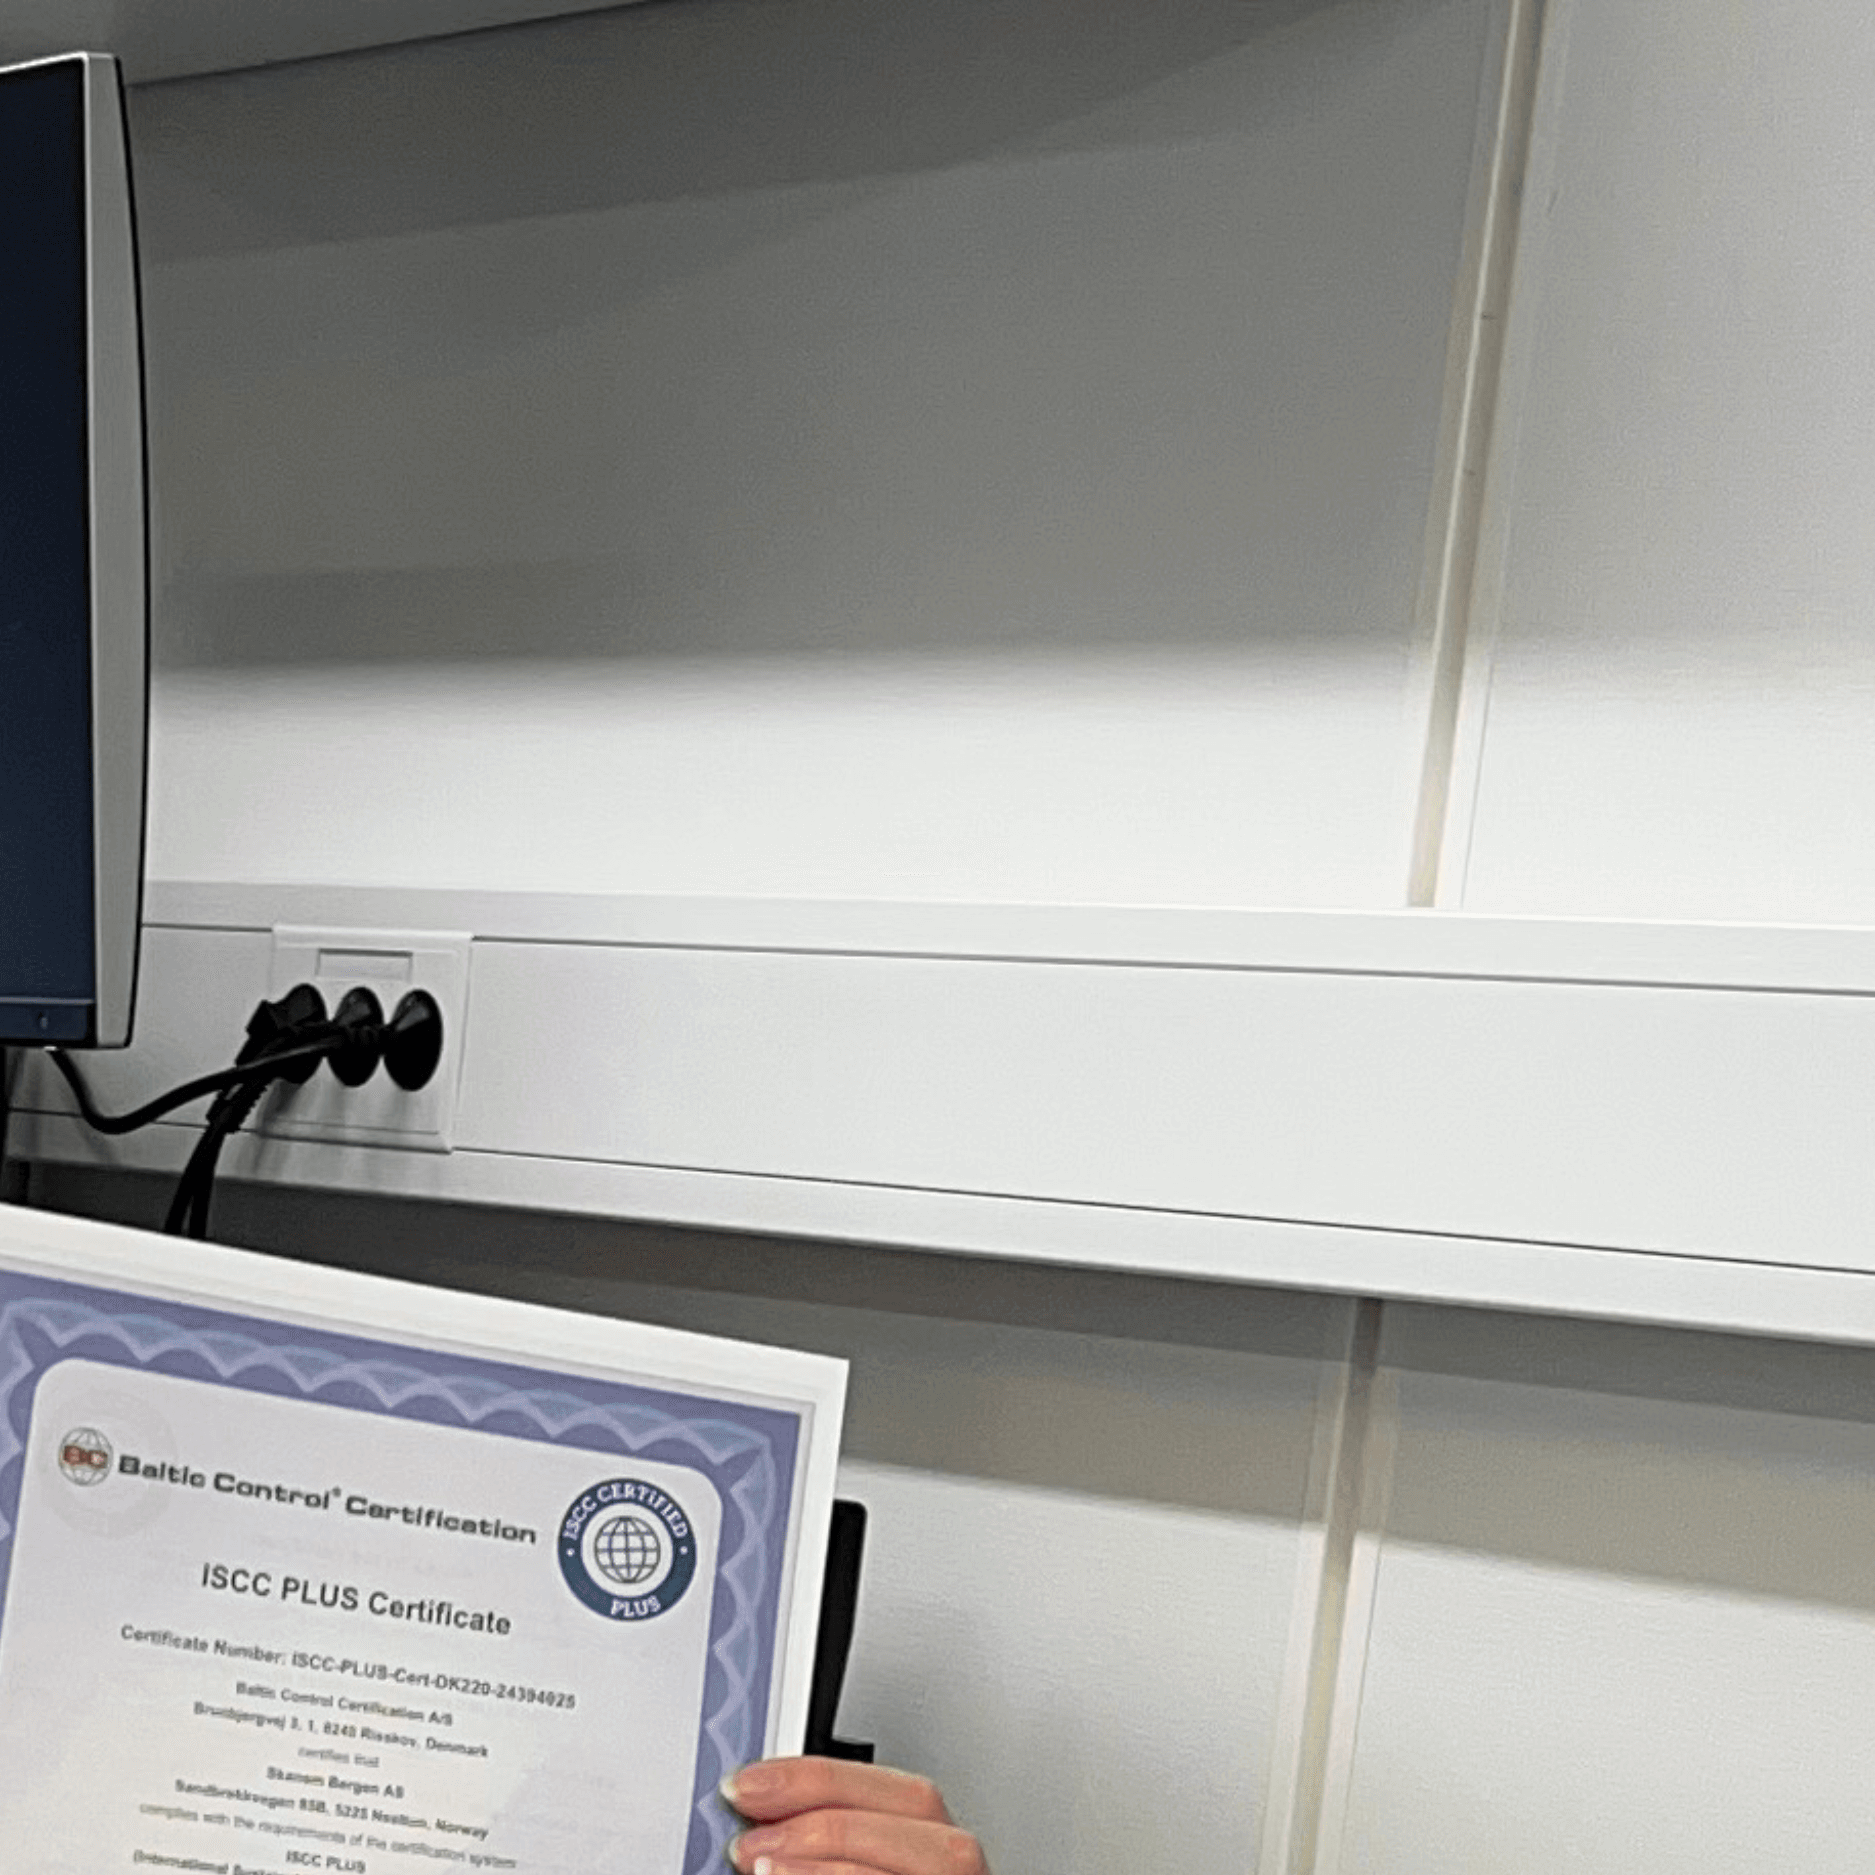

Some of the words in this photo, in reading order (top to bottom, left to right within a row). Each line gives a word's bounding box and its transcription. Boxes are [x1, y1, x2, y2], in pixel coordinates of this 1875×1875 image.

[117, 1454, 205, 1487] Baltic
[344, 1495, 536, 1544] Certification
[562, 1496, 597, 1540] ISCC
[597, 1481, 688, 1538] CERTIFIED
[201, 1563, 271, 1596] ISCC
[280, 1576, 358, 1610] PLUS
[368, 1591, 510, 1634] Certificate
[611, 1595, 661, 1617] PLUS
[120, 1624, 208, 1652] Certificate
[213, 1639, 287, 1663] Number:
[280, 1688, 333, 1707] Control
[337, 1696, 424, 1721] Certification
[285, 1850, 321, 1867] ISCC
[325, 1855, 365, 1874] PLUS
